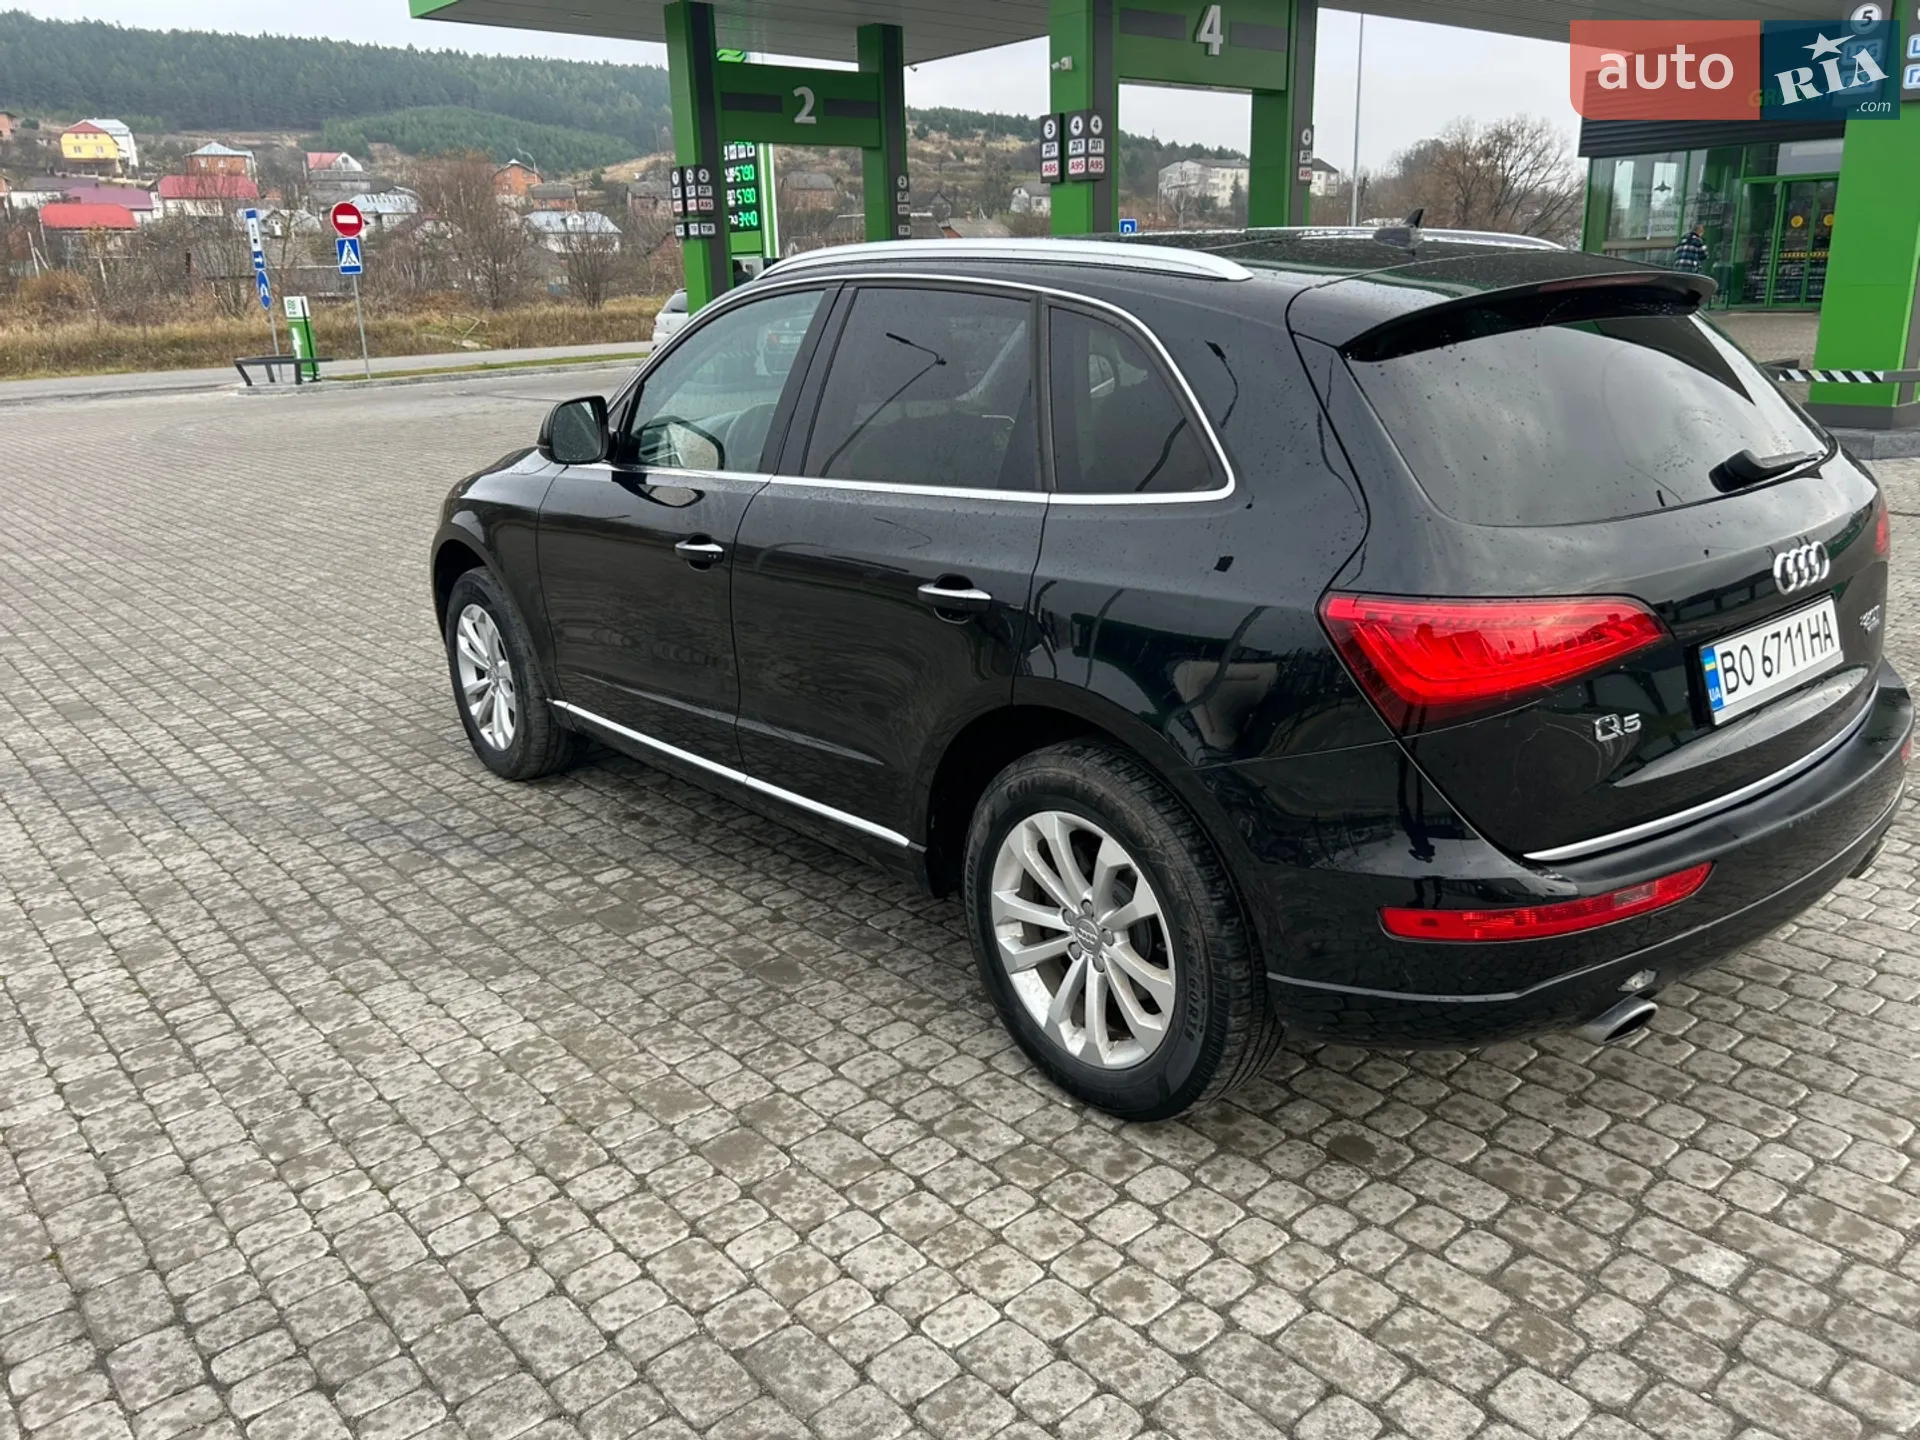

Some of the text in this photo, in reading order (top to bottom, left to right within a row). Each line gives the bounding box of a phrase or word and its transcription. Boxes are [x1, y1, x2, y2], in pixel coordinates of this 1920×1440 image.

[1197, 4, 1223, 55] 4
[1859, 9, 1873, 27] 5
[793, 86, 817, 124] 2
[1720, 610, 1835, 695] BO 6711 HA
[1708, 686, 1721, 702] UA
[1595, 713, 1642, 742] Q5
